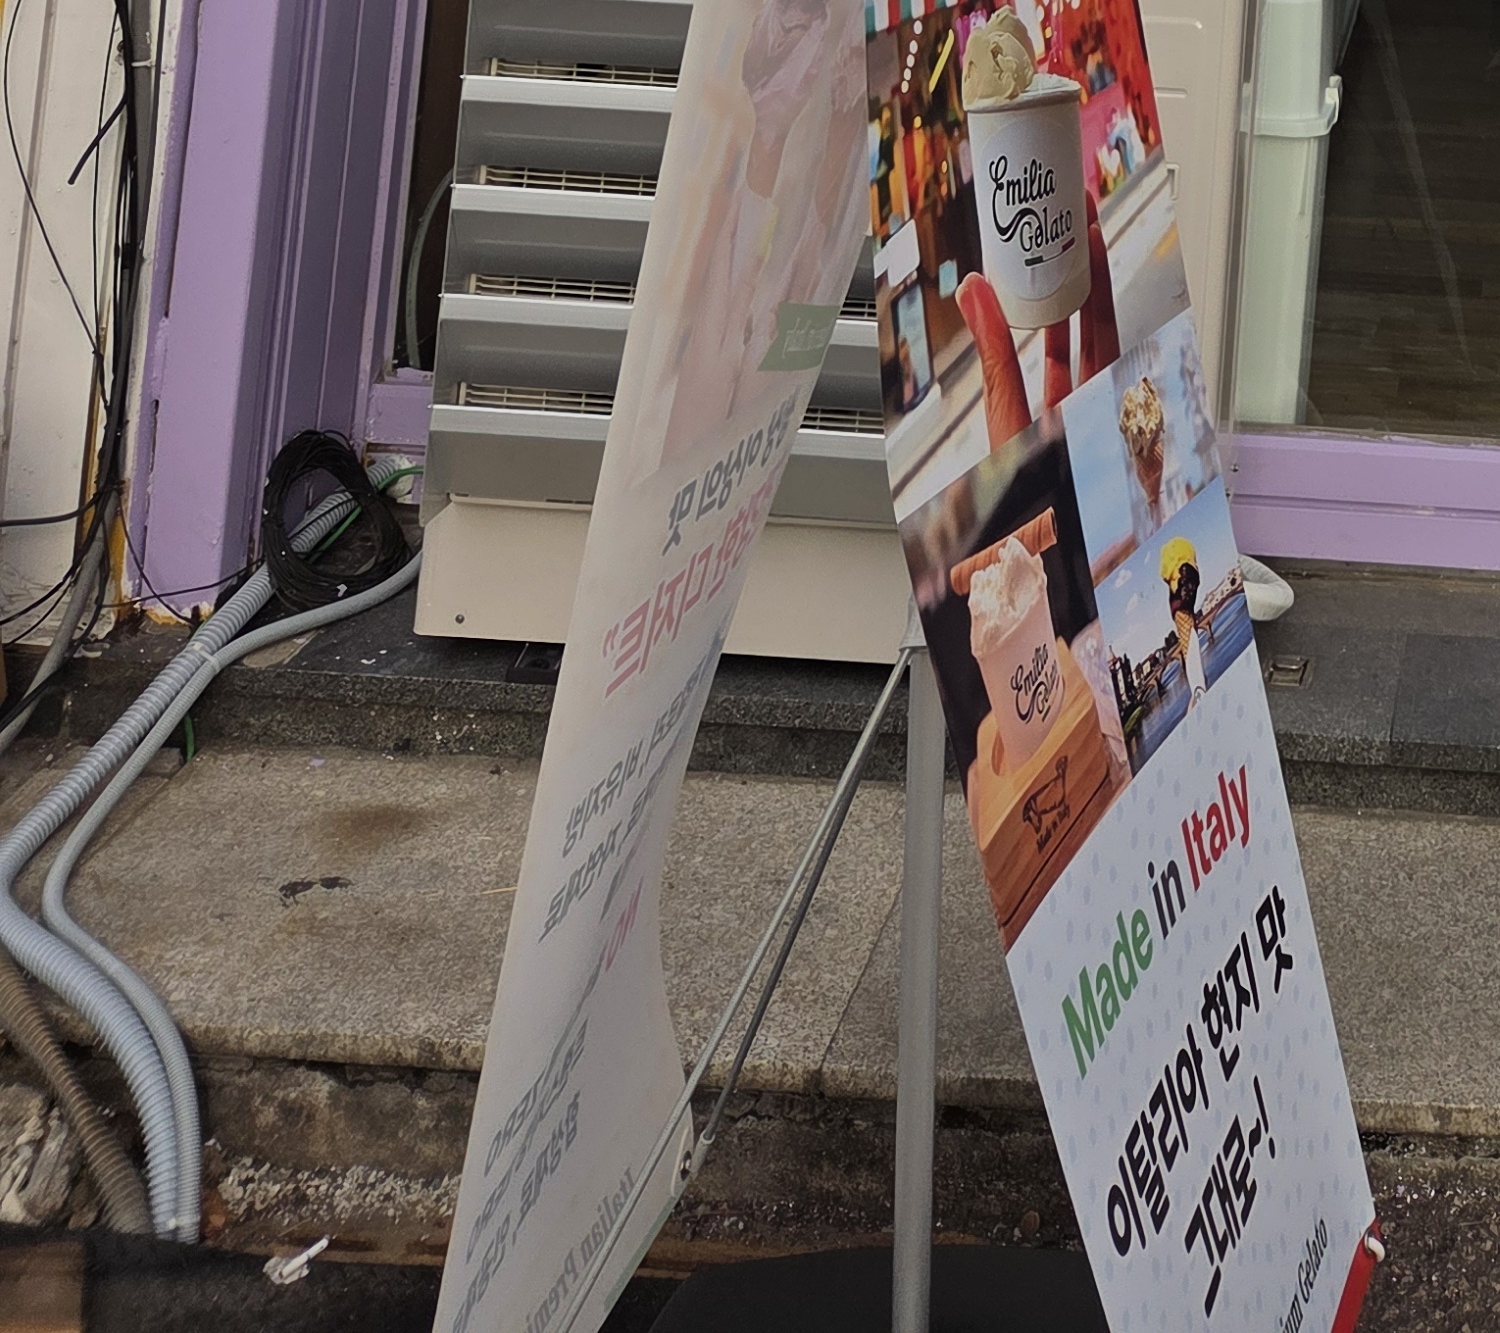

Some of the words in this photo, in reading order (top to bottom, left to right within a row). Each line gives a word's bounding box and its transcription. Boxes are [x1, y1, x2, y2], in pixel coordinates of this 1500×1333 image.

[989, 153, 1057, 228] Emilia
[1019, 207, 1074, 254] Gelato
[1010, 643, 1050, 701] Emilia
[1060, 907, 1154, 1081] Made
[1146, 860, 1187, 941] in
[1180, 764, 1250, 893] Italy
[1106, 1023, 1210, 1257] 이탈리아
[1200, 931, 1261, 1082] 현지
[1254, 885, 1294, 995] 맛
[1297, 1217, 1328, 1305] Gelato
